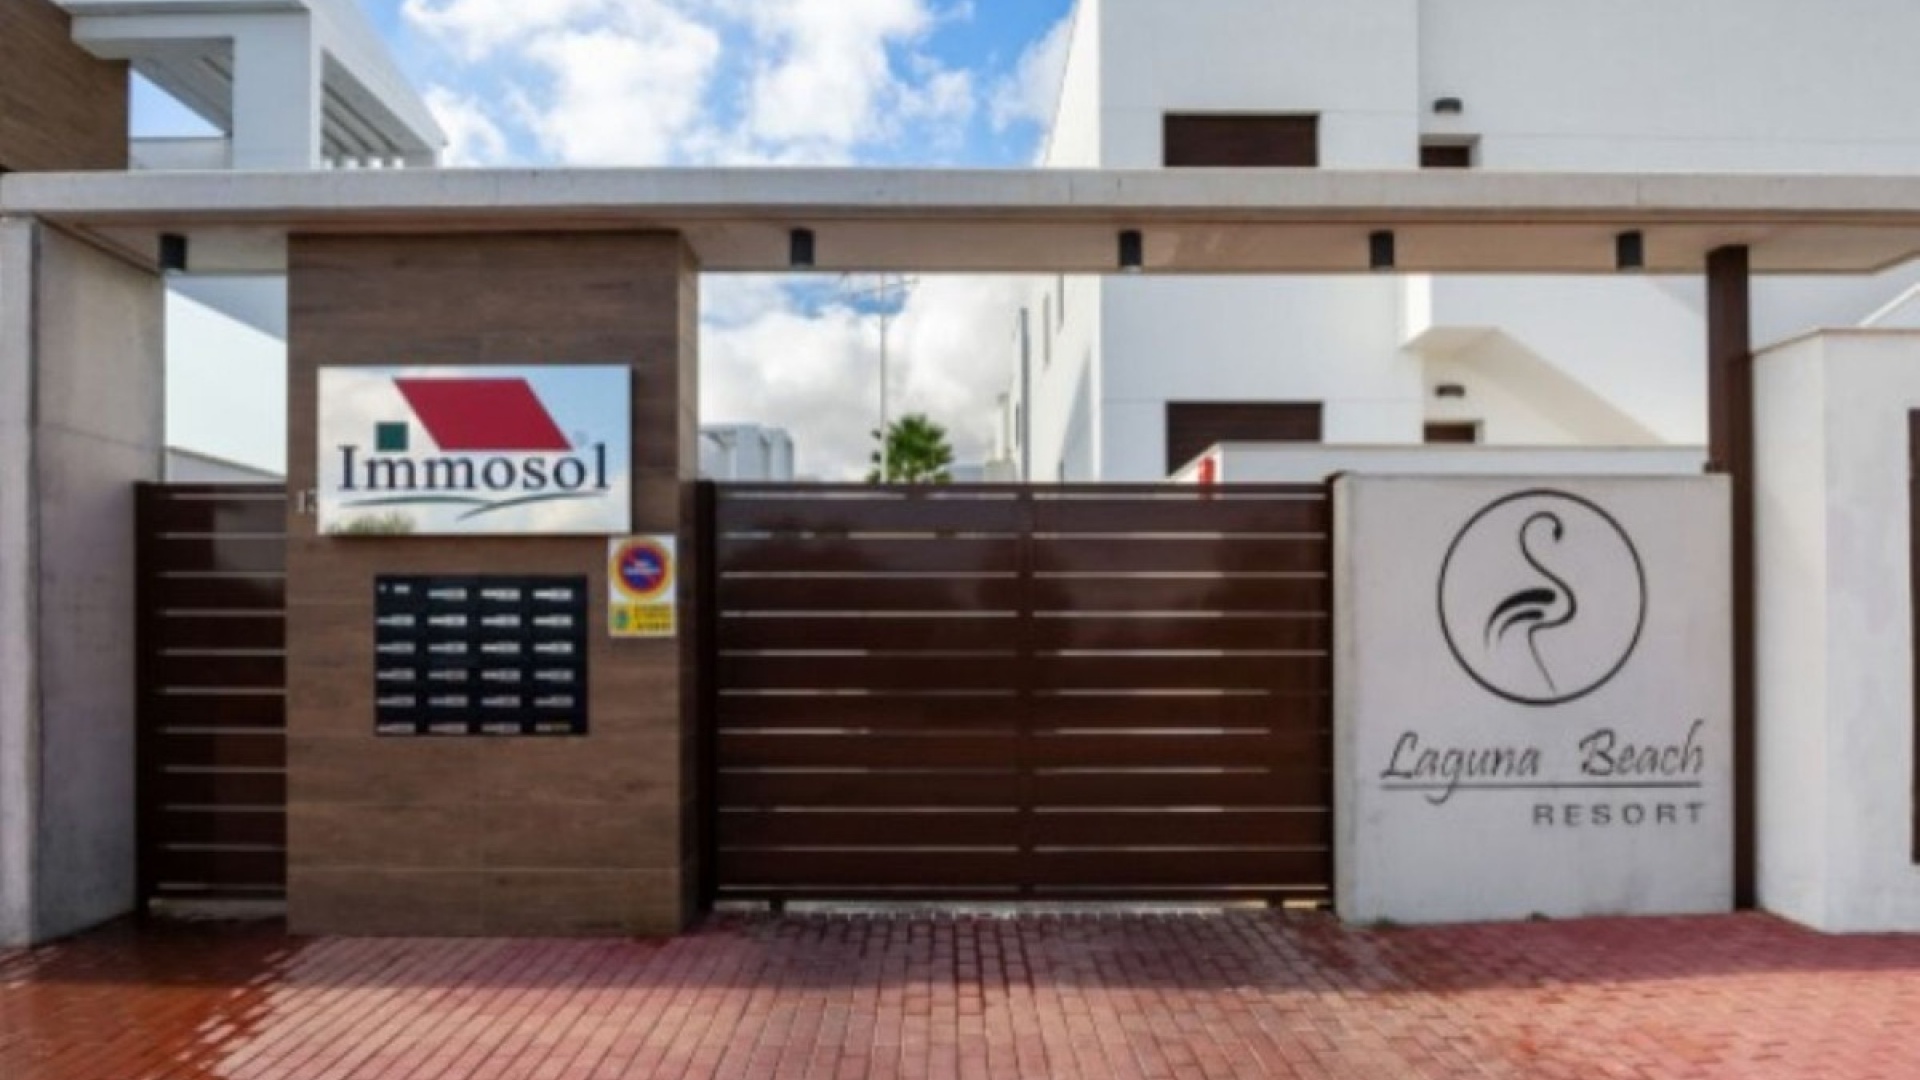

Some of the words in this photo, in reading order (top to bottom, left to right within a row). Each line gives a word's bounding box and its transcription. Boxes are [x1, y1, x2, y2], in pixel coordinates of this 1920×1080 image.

[338, 442, 609, 491] Immosol
[1380, 731, 1540, 804] Laguna
[1579, 719, 1704, 777] Beach
[1532, 802, 1705, 827] RESORT
